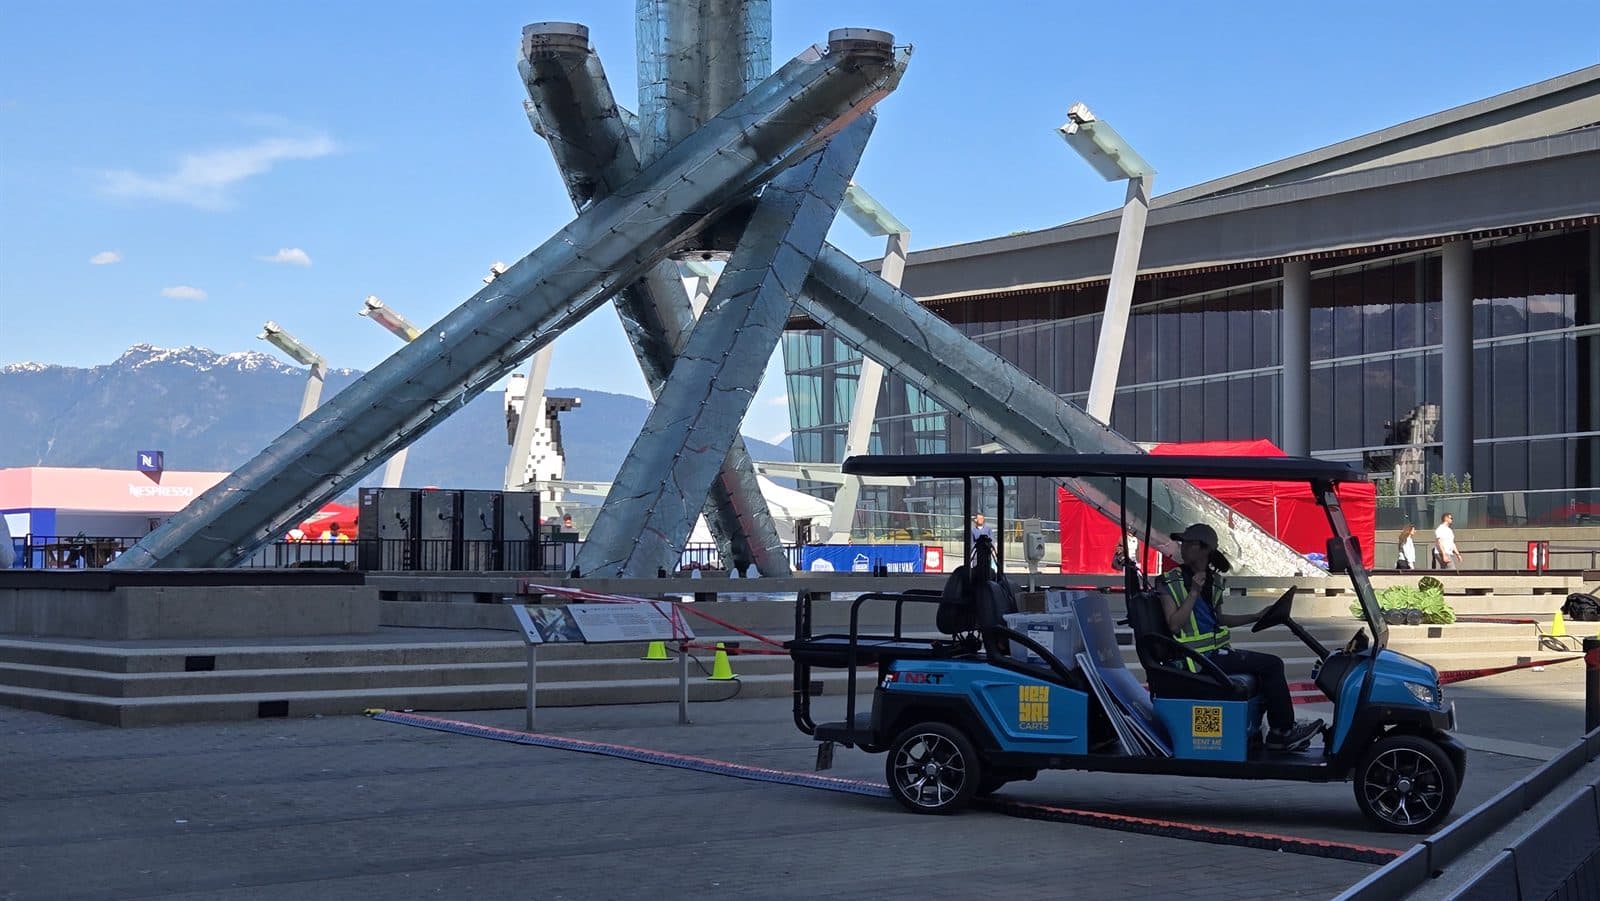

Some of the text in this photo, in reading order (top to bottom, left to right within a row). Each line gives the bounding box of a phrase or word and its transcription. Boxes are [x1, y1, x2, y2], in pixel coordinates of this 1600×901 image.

[128, 482, 193, 496] NESPRESSO
[904, 671, 945, 685] NXT
[1019, 722, 1049, 730] CARTS
